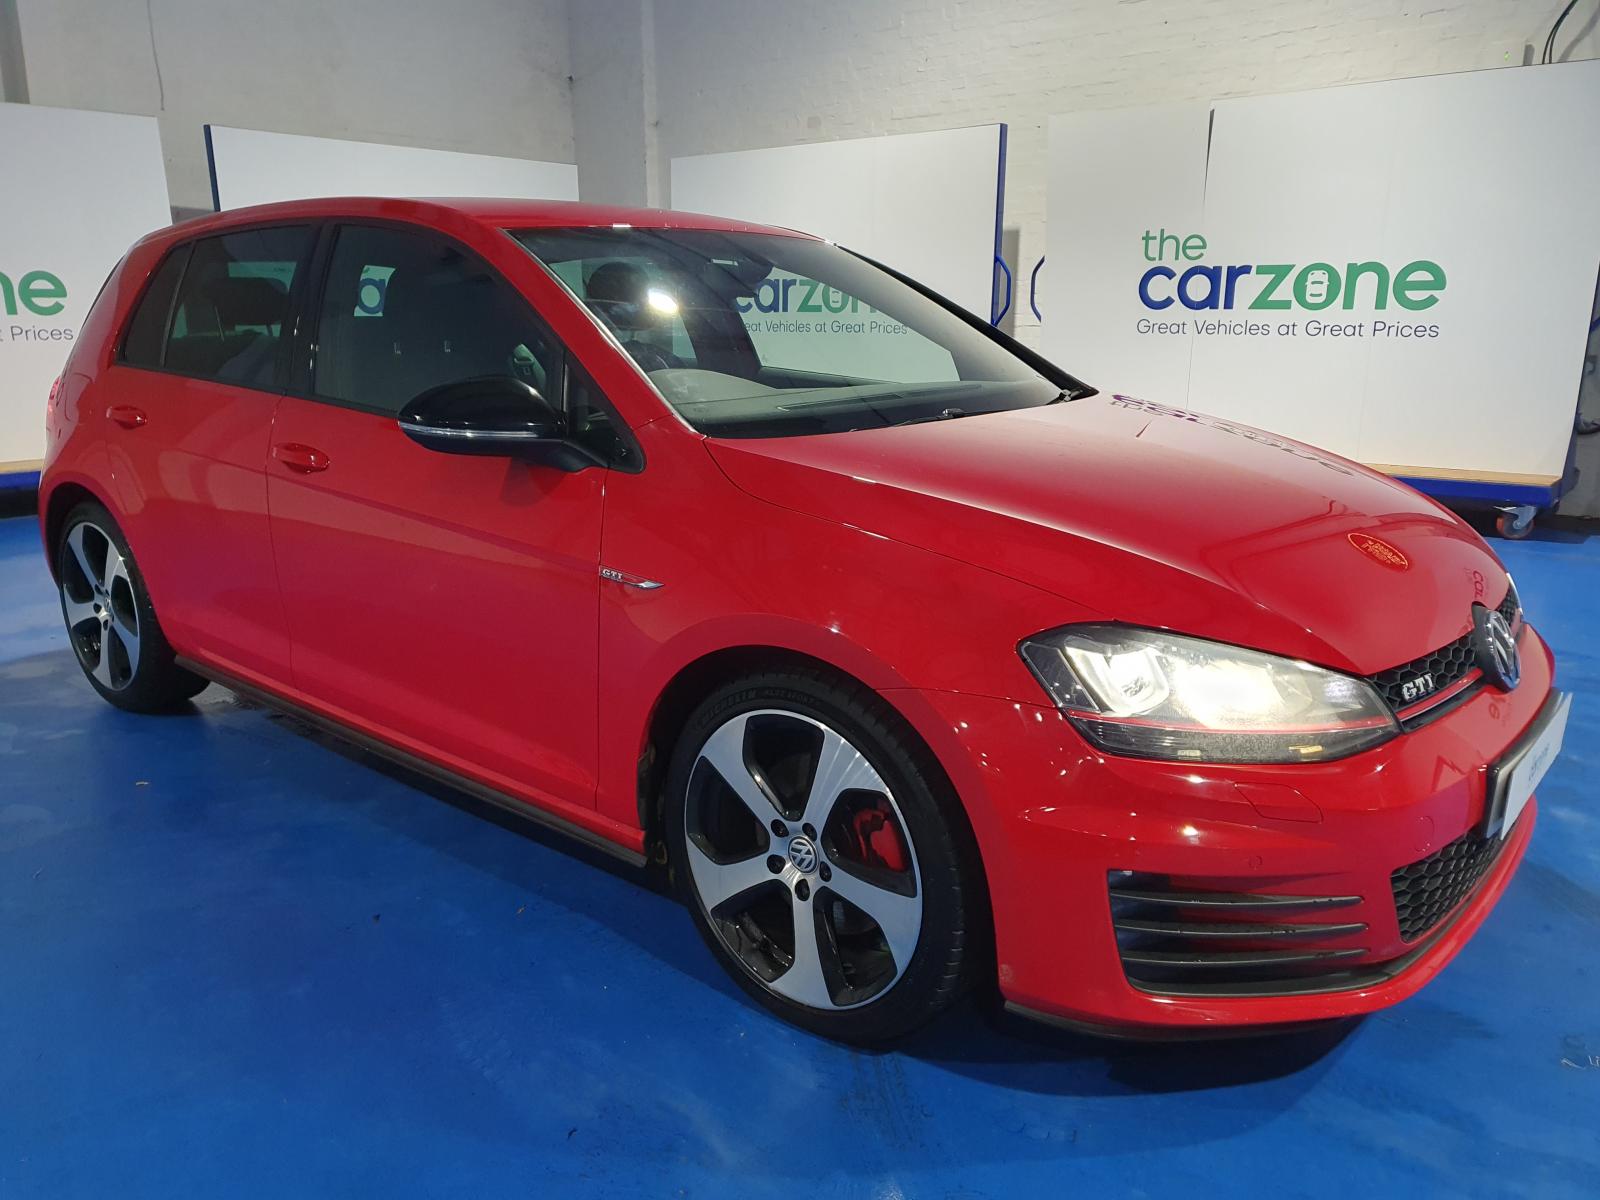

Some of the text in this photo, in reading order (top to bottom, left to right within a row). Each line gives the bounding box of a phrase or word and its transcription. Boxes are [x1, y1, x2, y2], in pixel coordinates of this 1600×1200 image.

[1141, 228, 1207, 262] the
[1138, 260, 1447, 311] carzone
[10, 325, 74, 341] Prices
[766, 319, 811, 334] Vehicles
[815, 321, 827, 333] at
[831, 320, 865, 334] Great
[870, 320, 908, 335] Prices
[1136, 318, 1440, 338] Great Vehicles at Great Prices
[602, 568, 623, 580] GTI
[1402, 673, 1435, 701] GTI
